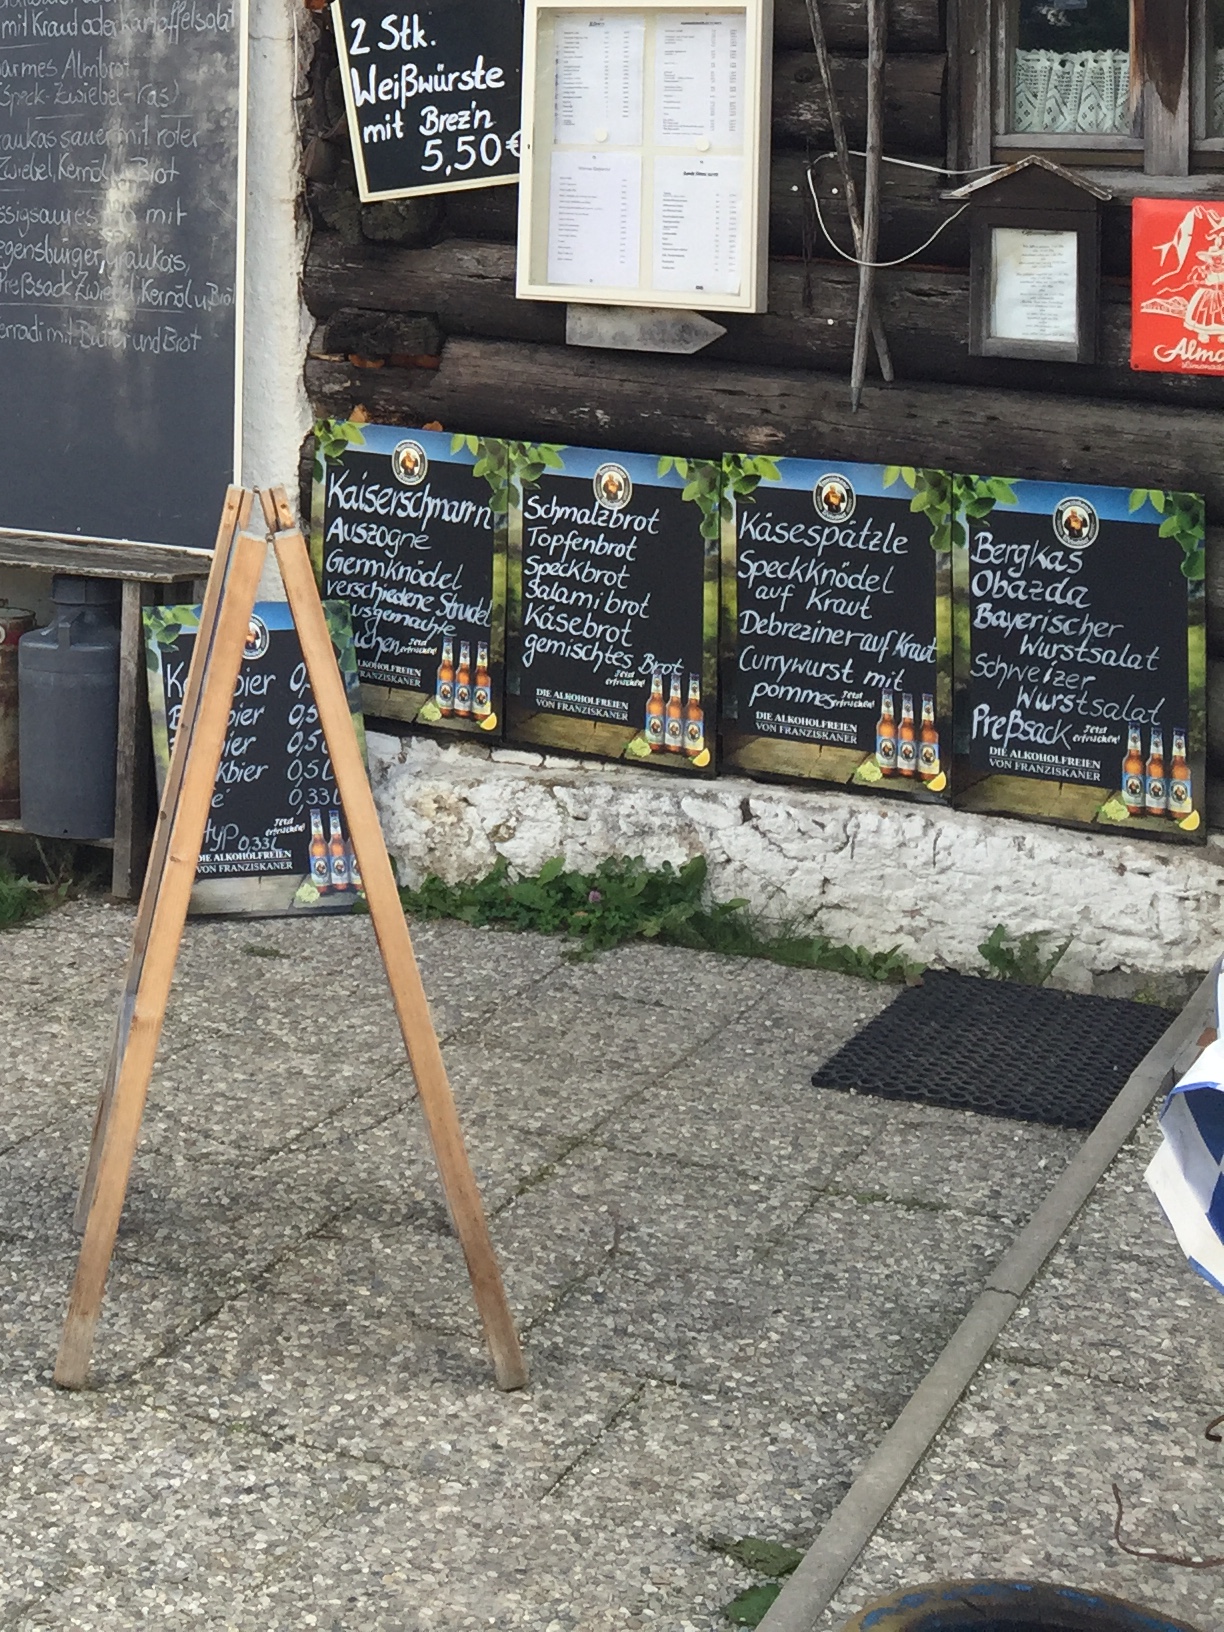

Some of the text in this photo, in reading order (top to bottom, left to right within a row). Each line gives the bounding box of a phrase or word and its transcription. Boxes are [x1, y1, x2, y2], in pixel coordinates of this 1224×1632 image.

[1, 5, 117, 38] mit Kraut oder
[349, 13, 436, 55] 2 Stk.
[351, 55, 505, 110] Weißwürste
[156, 119, 201, 148] roter
[363, 101, 496, 144] mit Brez'n
[146, 197, 188, 227] mit
[47, 316, 73, 345] mit
[132, 333, 161, 354] und
[163, 324, 202, 353] Brot
[327, 469, 493, 538] Kaiserschmarrn
[523, 495, 660, 535] Schmalzbrot
[326, 516, 431, 558] Auszogne
[527, 525, 638, 562] Topfenbrot
[738, 510, 910, 557] Käsespätzle
[325, 548, 464, 591] Germknödel
[523, 554, 631, 590] Speckbrot
[737, 549, 894, 594] Speckknödel
[970, 531, 1084, 578] Bergkas
[326, 578, 493, 628] verschiedene Strudel
[524, 578, 651, 619] Salamibrot
[755, 584, 873, 620] auf Kraut
[971, 569, 1091, 609] Obazda
[524, 601, 633, 647] Käsebrot
[739, 610, 938, 664] Debreziner auf Kraut
[973, 602, 1125, 639] Bayerischer
[522, 632, 685, 676] gemischtes Brot
[739, 644, 906, 692] Currywurst mit
[970, 653, 1096, 690] Schweizer
[1018, 634, 1161, 671] Wurstsalat
[536, 688, 629, 710] DIE ALKOHOLFREIEN
[536, 698, 629, 722] VON FRANZISKANER
[748, 680, 836, 711] pommes
[1015, 686, 1166, 726] Wurstsalat
[755, 710, 858, 733] DIE ALKOHOLFREIEN
[755, 721, 858, 745] VON FRANZISKANER
[972, 704, 1073, 751] Preßsack
[989, 746, 1101, 770] DIE ALKOHOLFREIEN
[989, 757, 1101, 782] VON FRANZISKANER
[213, 849, 292, 862] ALKOHOLFREIEN
[218, 861, 293, 873] FRANZISKANER
